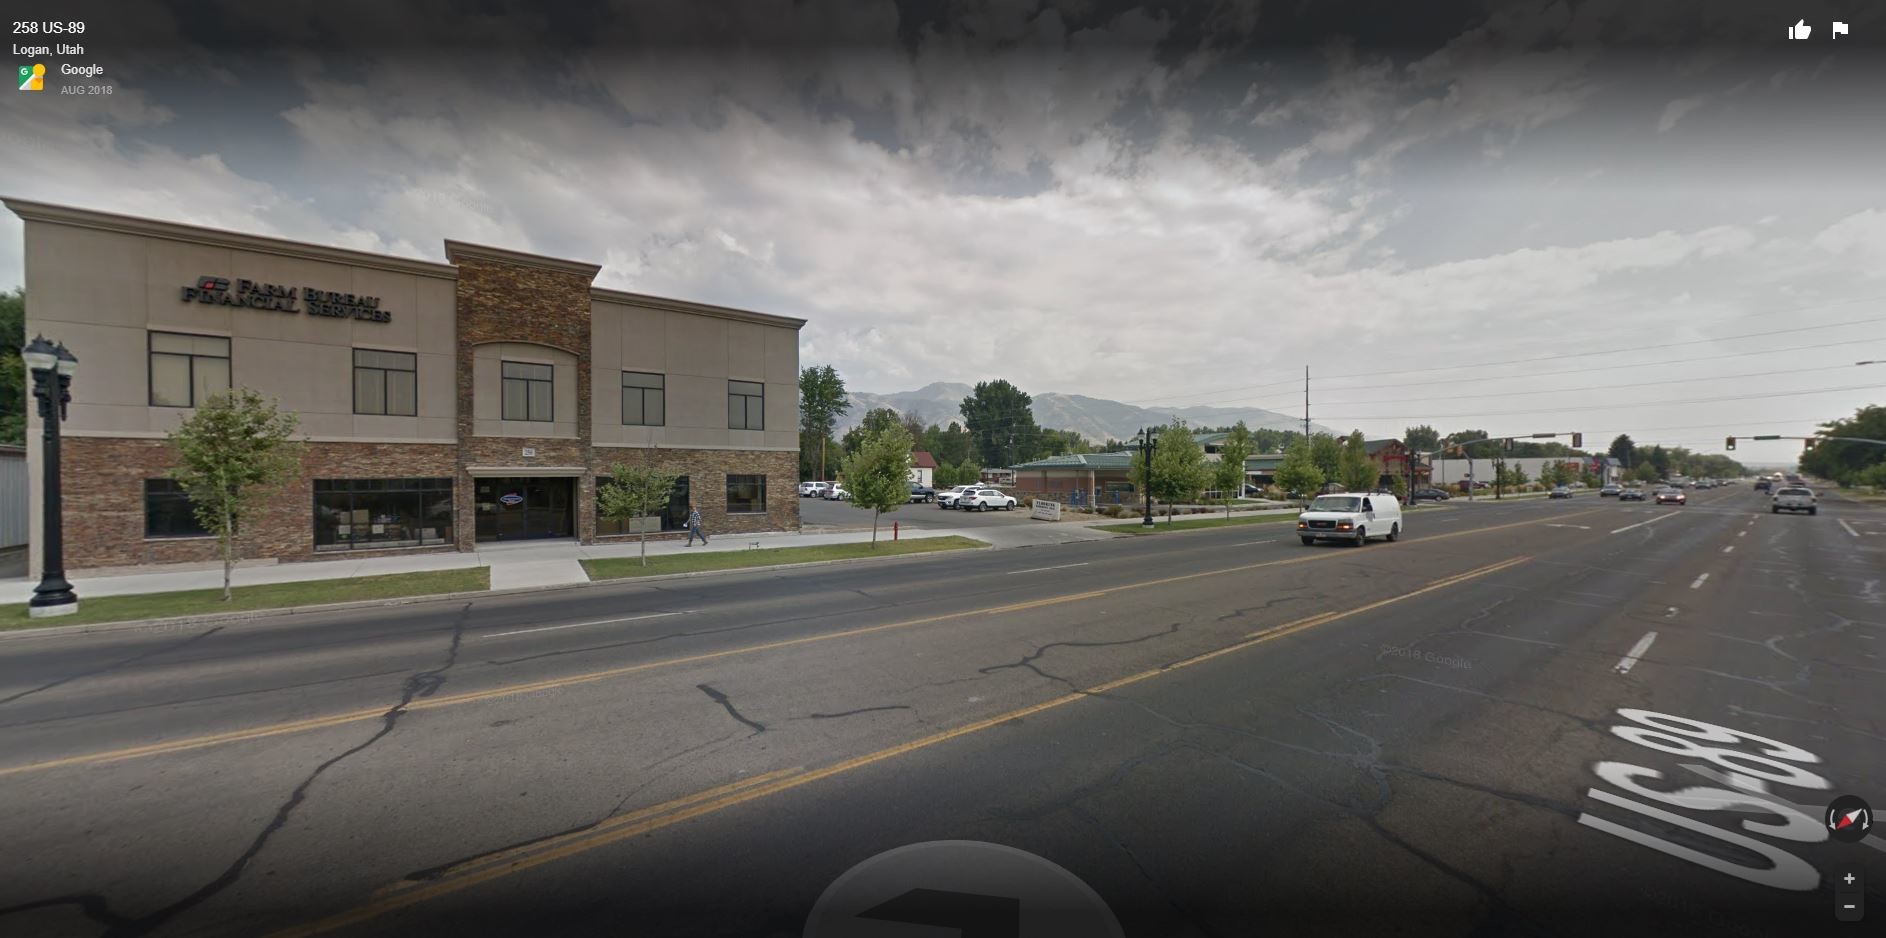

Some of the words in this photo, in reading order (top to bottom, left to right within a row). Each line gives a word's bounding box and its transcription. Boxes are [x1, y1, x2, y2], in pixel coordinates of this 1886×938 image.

[181, 286, 300, 314] FINANCIAL
[306, 302, 392, 323] SERVICES
[236, 278, 298, 300] FARM
[303, 287, 381, 309] BUREAU
